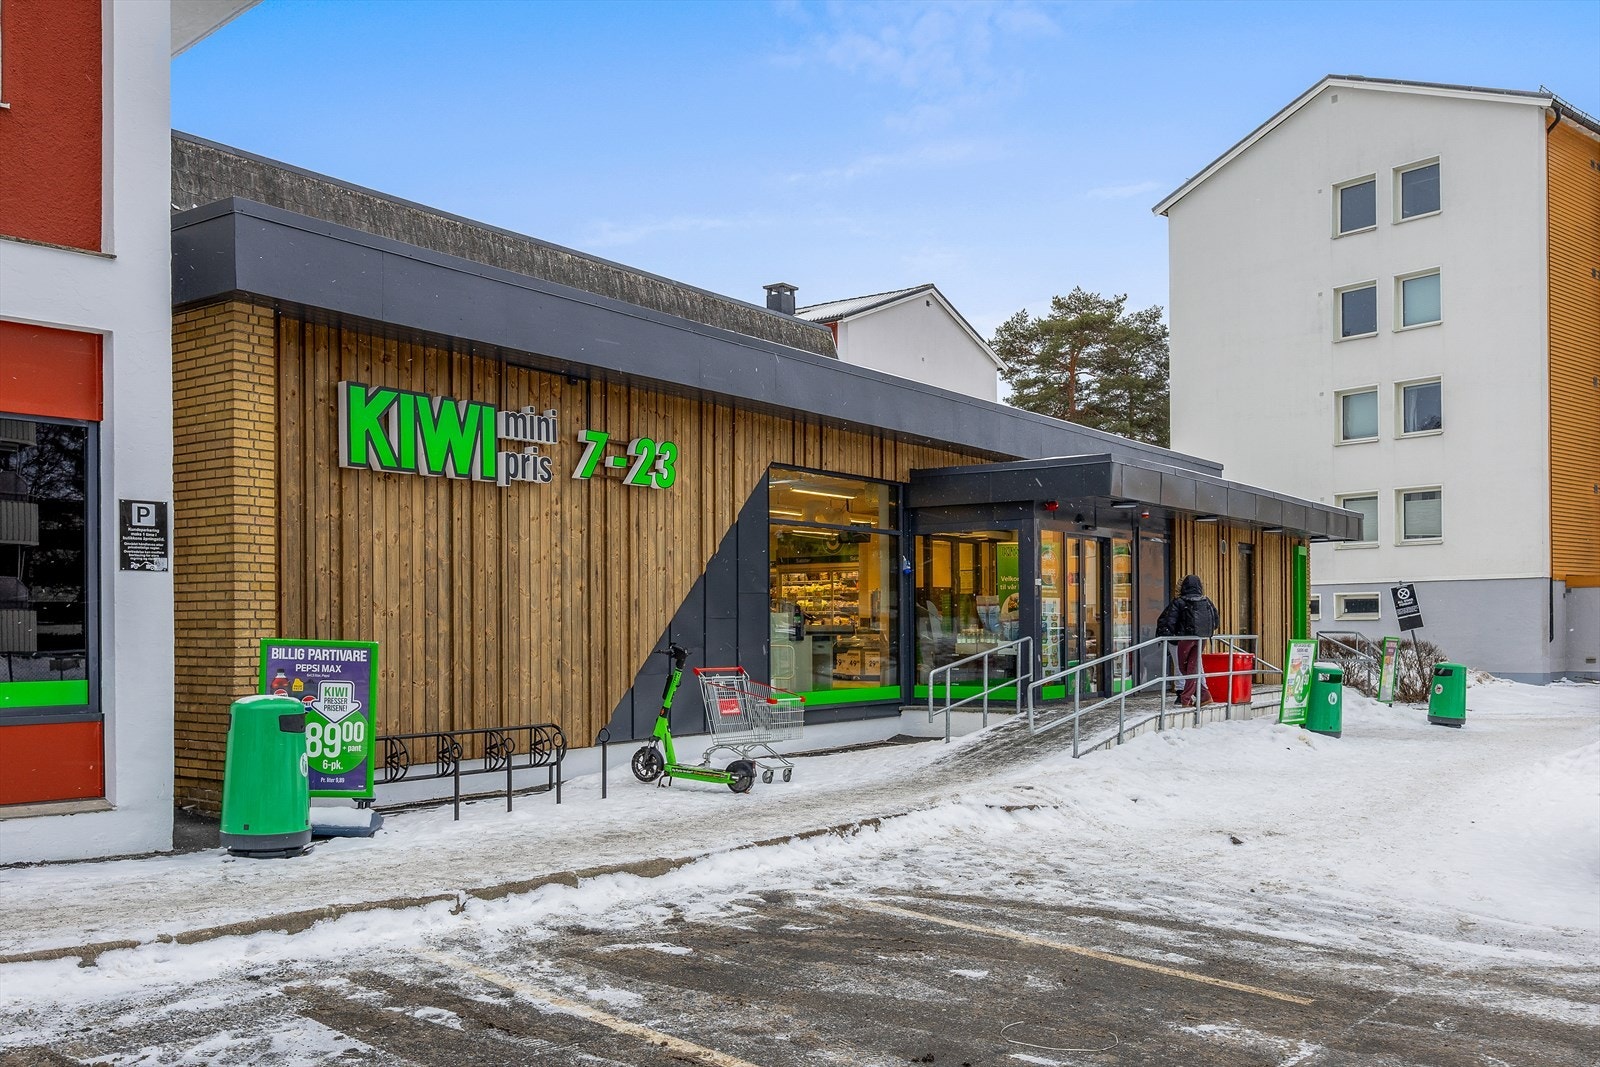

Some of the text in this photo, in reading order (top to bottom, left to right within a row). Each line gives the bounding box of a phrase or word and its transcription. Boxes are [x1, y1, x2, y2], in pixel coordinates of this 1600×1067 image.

[339, 381, 498, 483] KIWI
[498, 406, 558, 444] mini
[498, 446, 554, 487] pris
[272, 648, 367, 662] BILLIG PARTIVARE
[296, 664, 342, 673] PEPSI MAX
[324, 687, 348, 697] KIWI
[322, 760, 344, 771] 6-pk.
